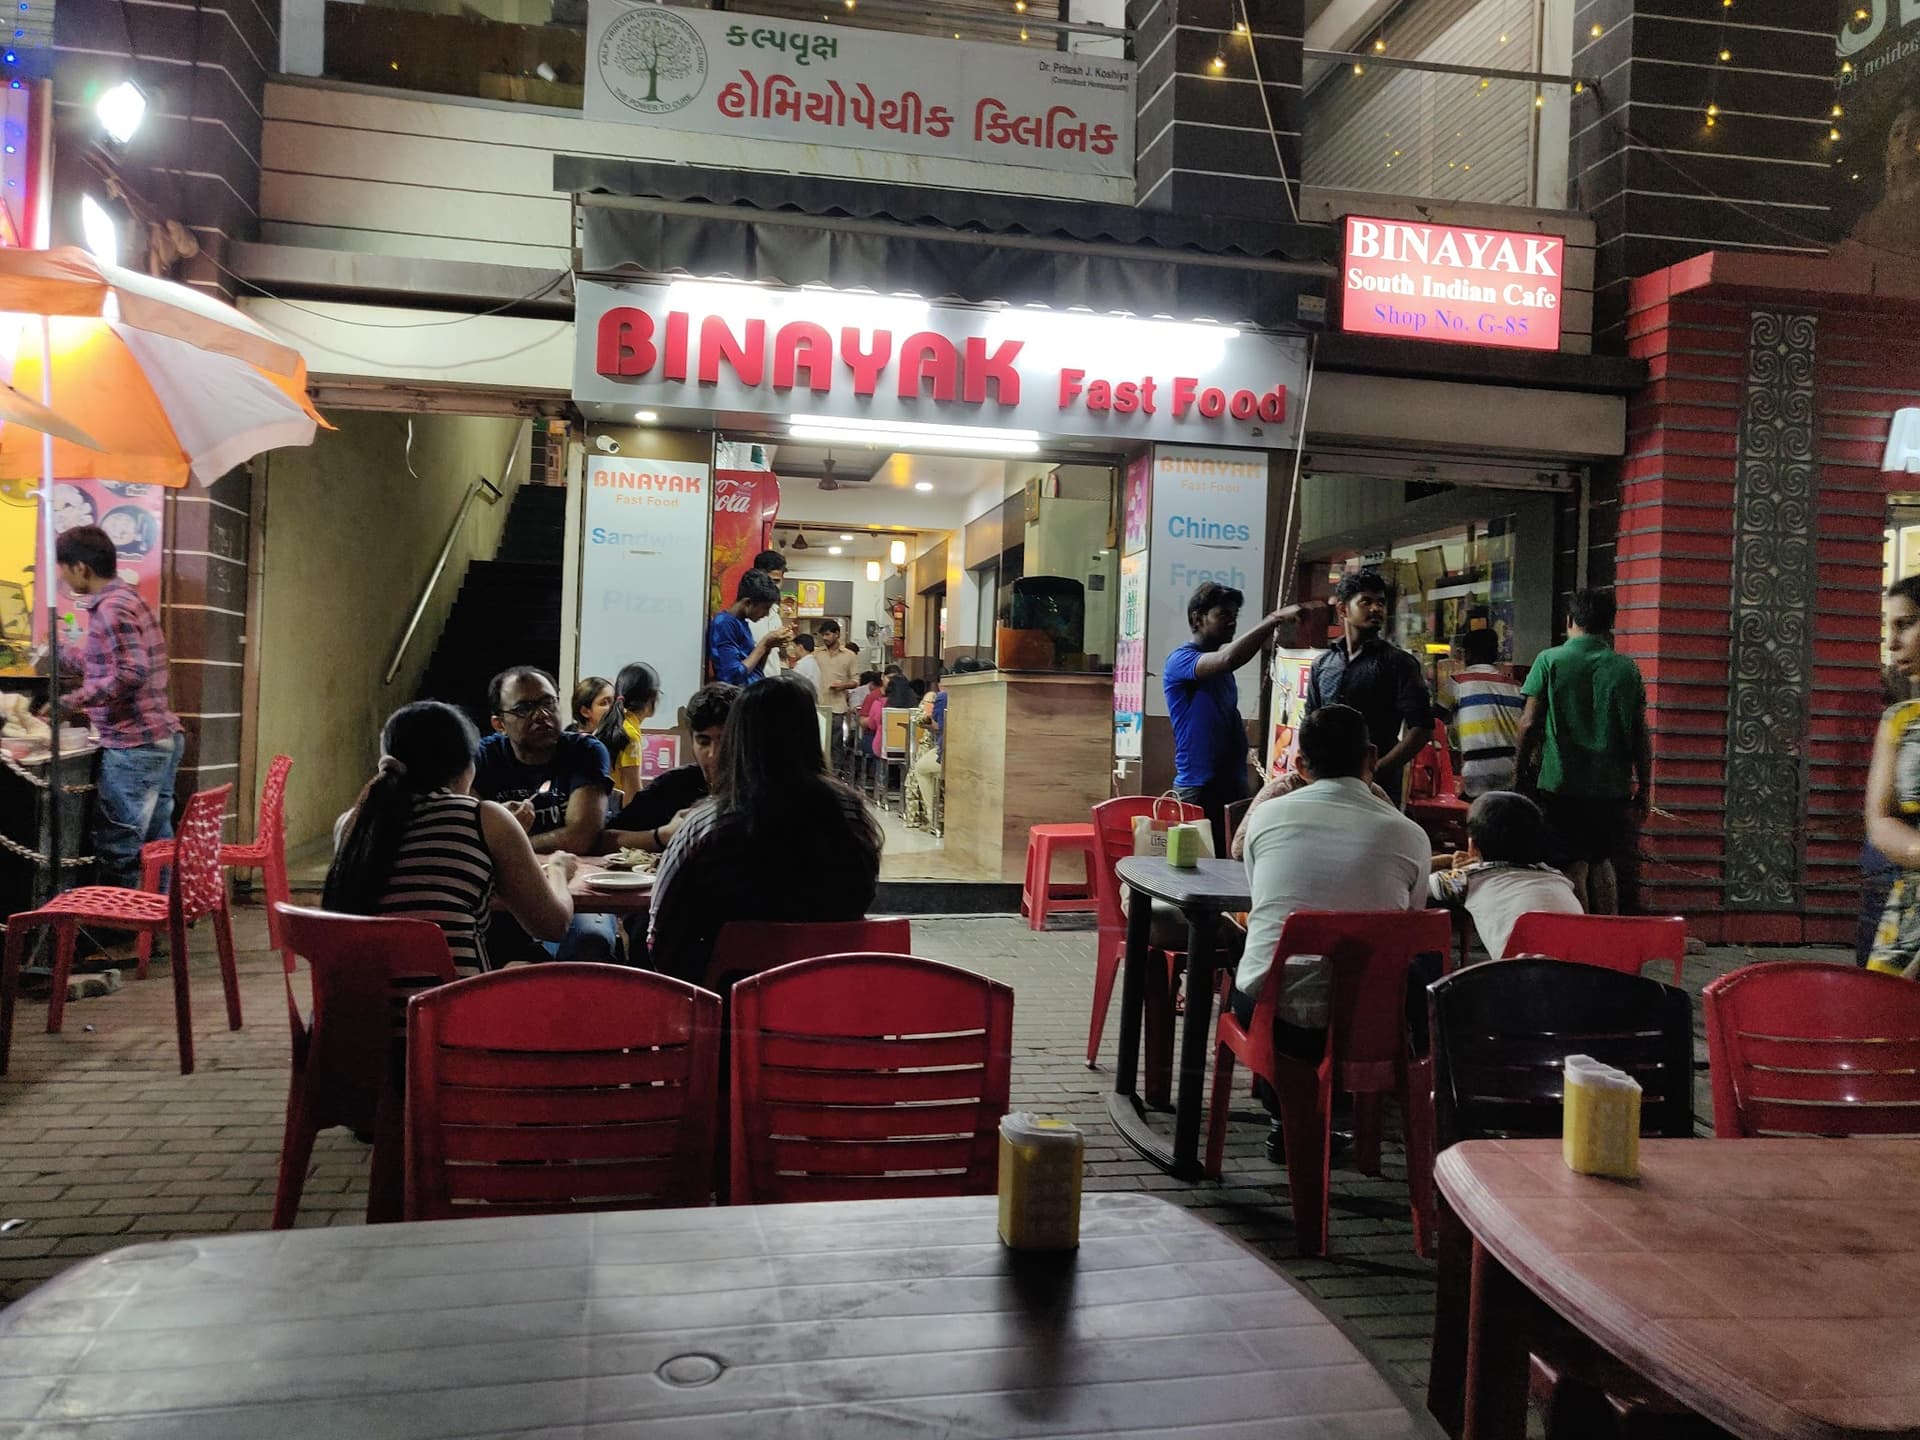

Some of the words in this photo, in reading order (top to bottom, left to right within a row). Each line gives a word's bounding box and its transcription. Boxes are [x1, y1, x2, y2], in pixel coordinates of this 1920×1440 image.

[601, 43, 609, 66] KALP
[726, 25, 838, 66] કલ્પવૃક્ષ
[1039, 61, 1050, 72] Dr.
[1086, 66, 1093, 77] J.
[630, 98, 659, 111] POWER
[660, 103, 672, 111] TO
[717, 69, 955, 138] હોમિયોપેથીક
[974, 97, 1119, 155] ક્લિનિક
[1349, 221, 1559, 277] BINAYAK
[1347, 268, 1415, 296] South
[1423, 275, 1497, 304] Indian
[1503, 283, 1557, 309] Cafe
[1373, 303, 1426, 331] Shop
[1435, 309, 1469, 332] No.
[1478, 313, 1529, 337] G-85
[597, 307, 1024, 405] BINAYAK
[1058, 368, 1158, 415] Fast
[1171, 377, 1288, 423] Food
[1160, 456, 1262, 480] BINAYAK
[594, 470, 702, 494] BINAYAK
[616, 494, 643, 505] Fast
[647, 496, 679, 508] Food
[1168, 516, 1250, 541] Chines
[1170, 562, 1246, 589] Fresh
